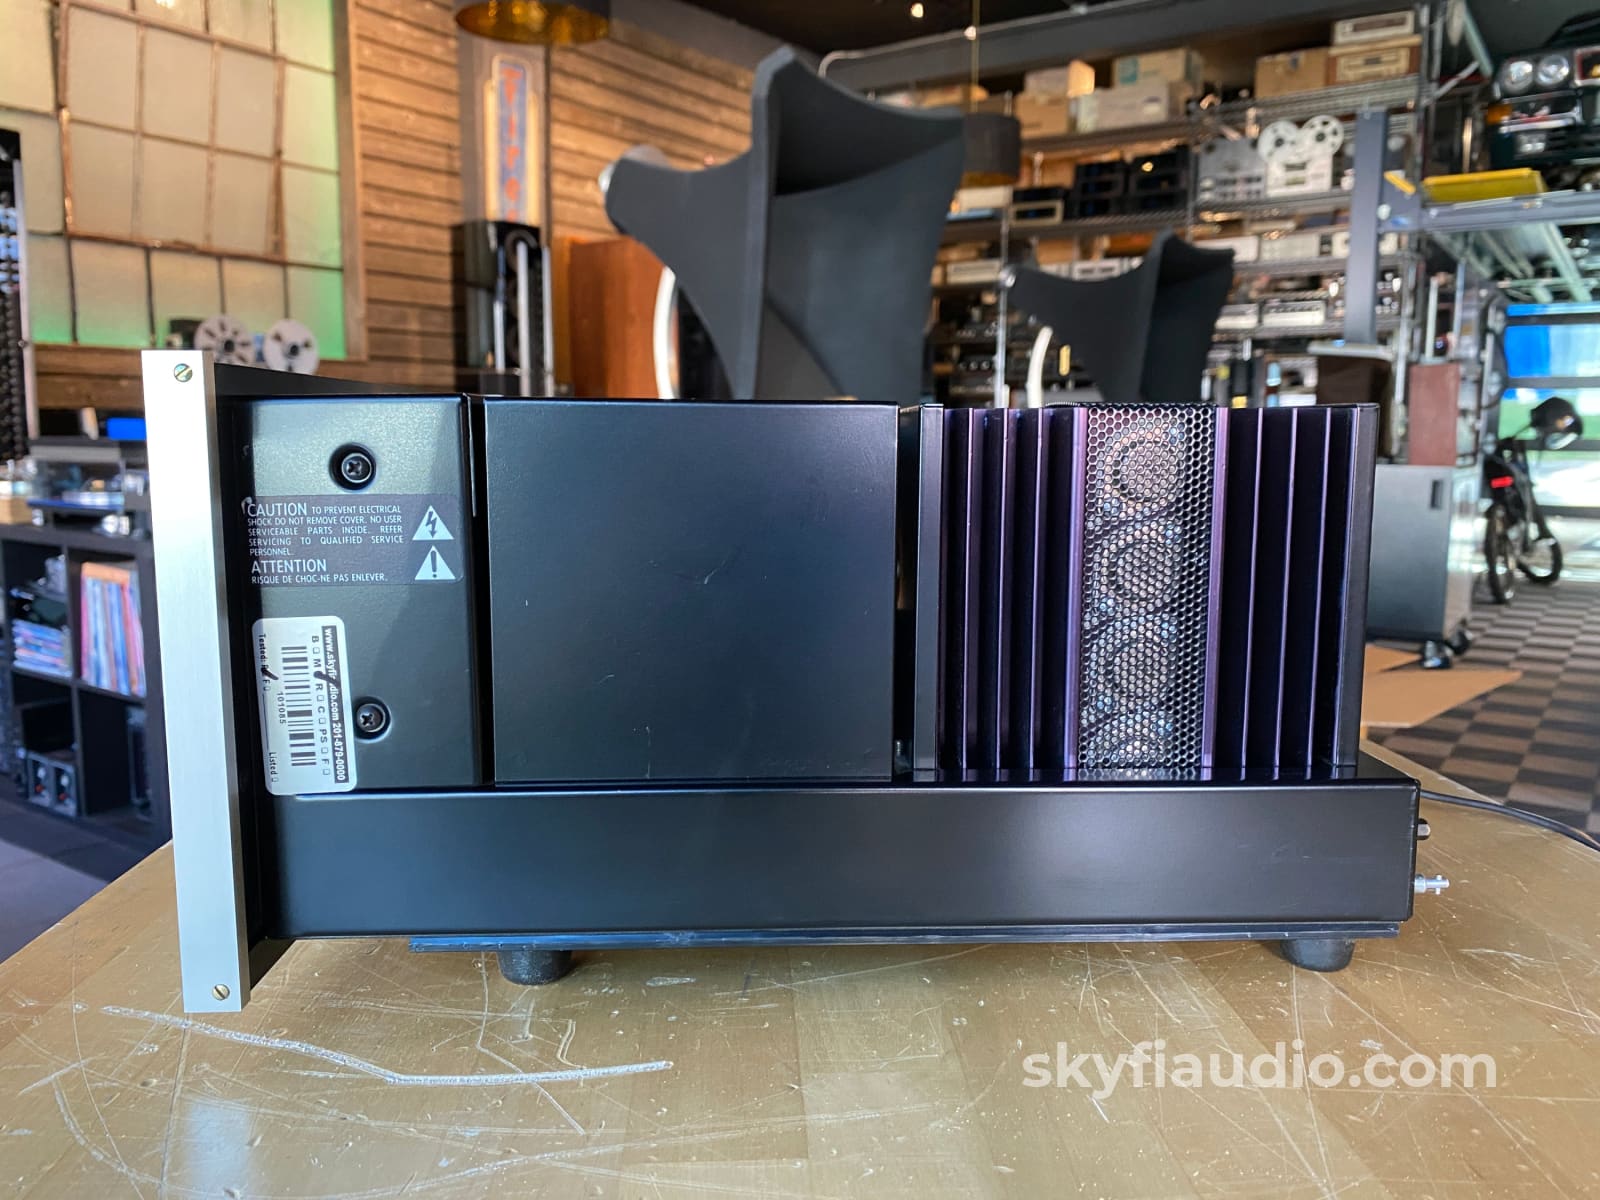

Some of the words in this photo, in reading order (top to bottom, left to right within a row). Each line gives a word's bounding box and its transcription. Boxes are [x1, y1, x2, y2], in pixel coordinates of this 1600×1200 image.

[248, 503, 307, 517] CAUTION
[324, 506, 356, 514] PREVENT
[359, 505, 401, 513] ELECTRICAL
[248, 518, 272, 526] SHOCK
[289, 517, 303, 525] NOT
[340, 516, 367, 524] COVER.
[384, 515, 402, 523] USER
[248, 527, 298, 536] SERVICEABLE
[342, 526, 370, 534] INSIDE.
[249, 538, 291, 546] SERVICING
[300, 537, 311, 545] TO
[320, 536, 362, 544] QUALIFIED
[371, 535, 403, 543] SERVICE
[250, 548, 294, 556] PERSONNEL.
[251, 559, 327, 573] ATTENTION
[252, 575, 279, 584] RISQUE
[283, 575, 292, 583] DE
[296, 574, 330, 583] CHOC-NE
[334, 574, 349, 582] PAS
[352, 573, 387, 581] ENLEVER.
[313, 659, 321, 667] M
[316, 683, 324, 691] R
[258, 634, 267, 662] Tested:
[269, 752, 278, 775] Listed
[278, 692, 286, 724] 101085
[325, 628, 339, 720] www.skyfidio.com
[333, 723, 346, 780] 201-879-0000
[319, 729, 328, 743] PS
